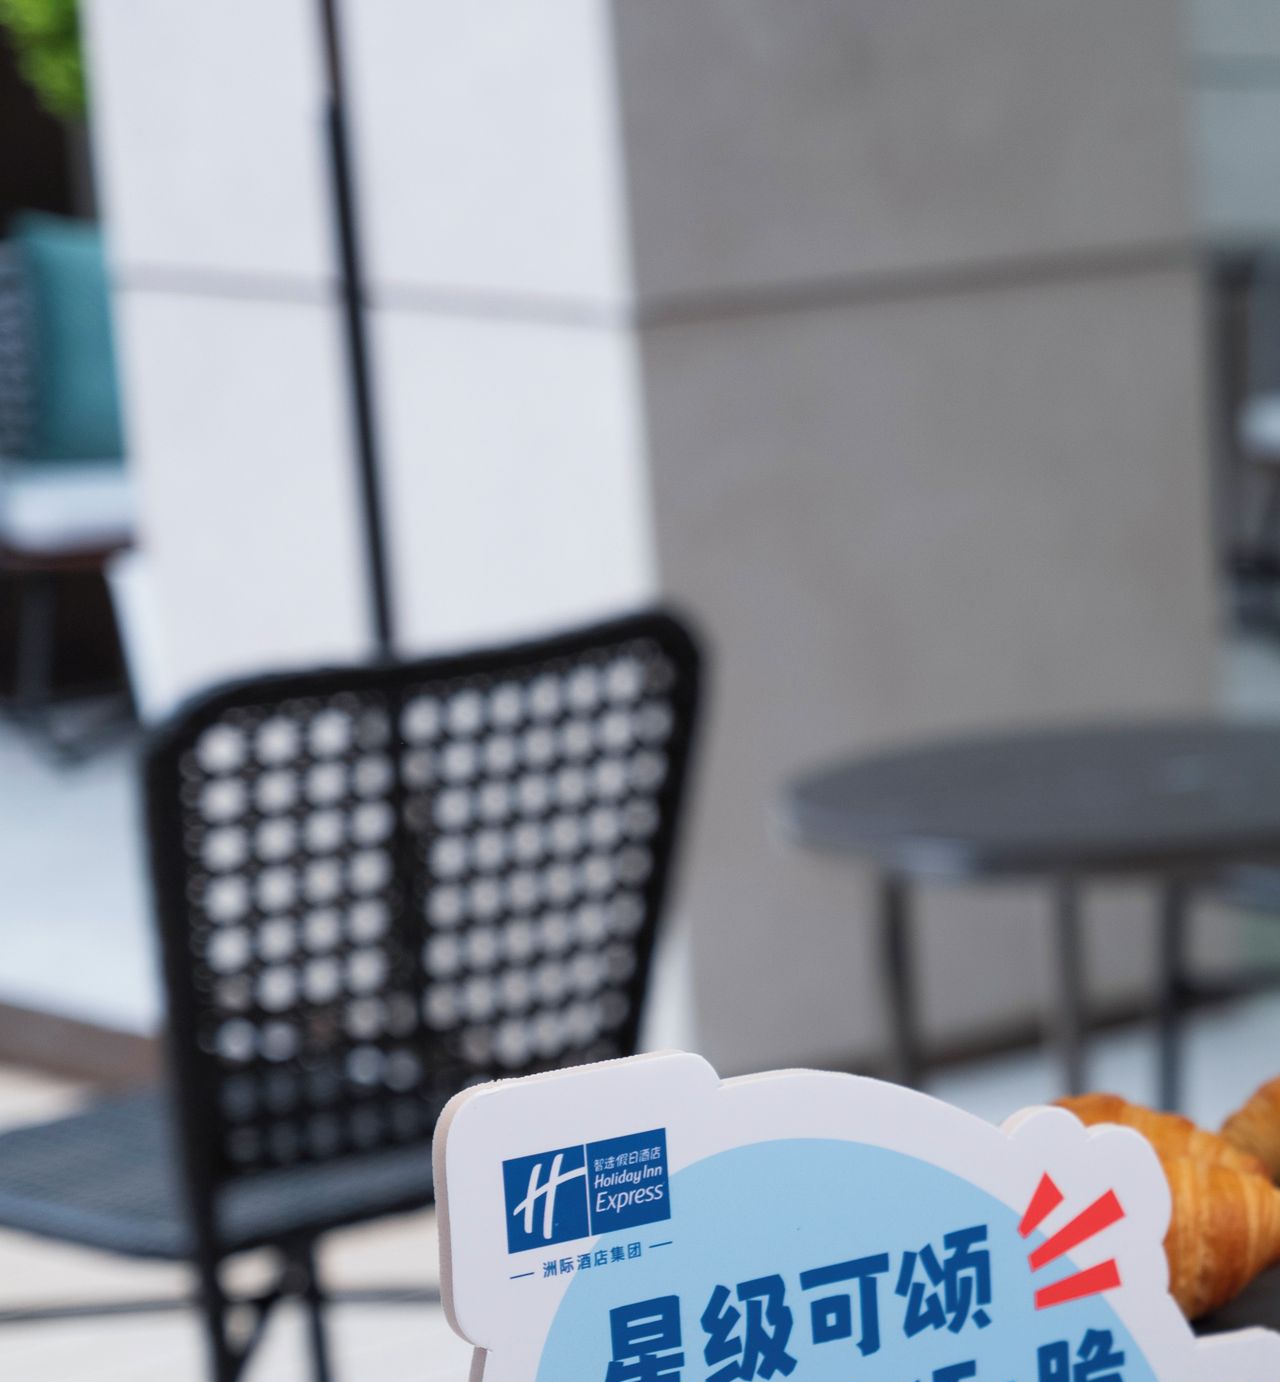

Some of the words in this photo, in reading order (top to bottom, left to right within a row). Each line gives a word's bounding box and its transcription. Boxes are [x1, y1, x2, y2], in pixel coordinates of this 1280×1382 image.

[594, 1170, 641, 1189] Holiday
[643, 1164, 663, 1180] Inn
[596, 1184, 664, 1214] Express
[543, 1241, 642, 1278] 洲际酒店集团
